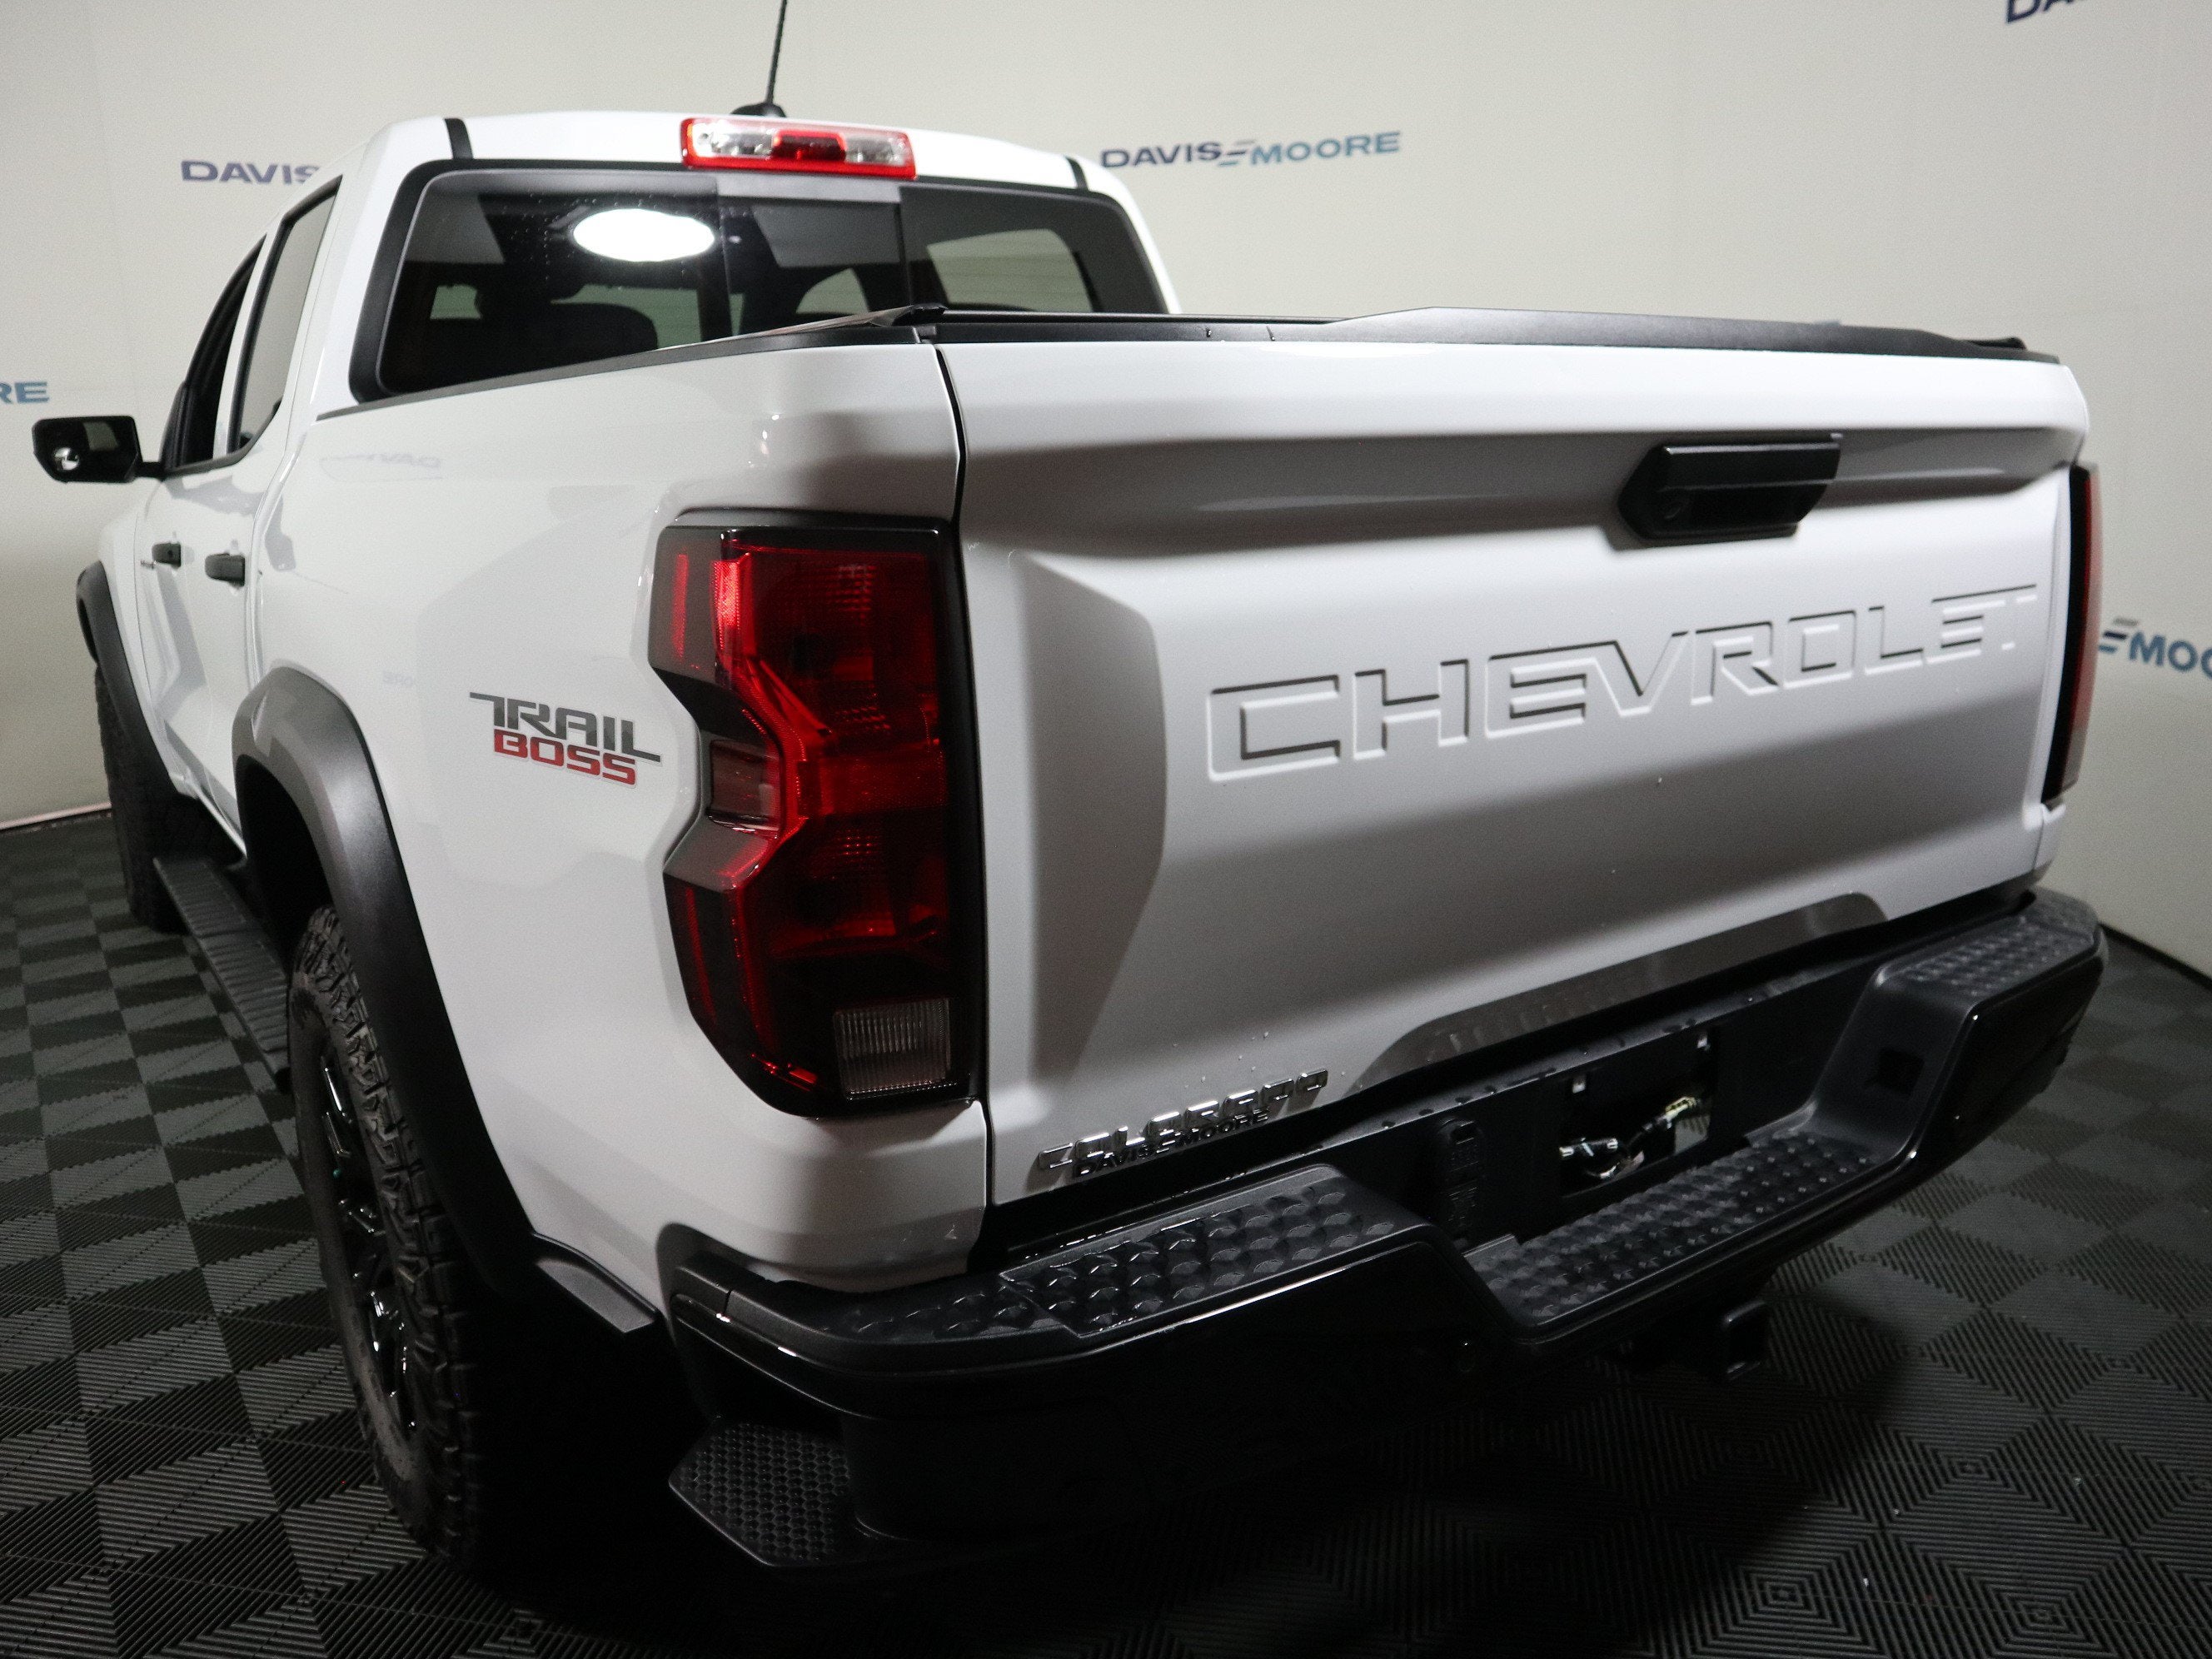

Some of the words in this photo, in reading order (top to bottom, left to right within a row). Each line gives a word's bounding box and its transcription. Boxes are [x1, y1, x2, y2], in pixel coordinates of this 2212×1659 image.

[1100, 141, 1222, 167] DAVIS
[1251, 131, 1401, 165] MOORE
[1208, 583, 2038, 782] CHEVROLET
[469, 691, 661, 763] TRAIL
[493, 728, 636, 786] BOSS
